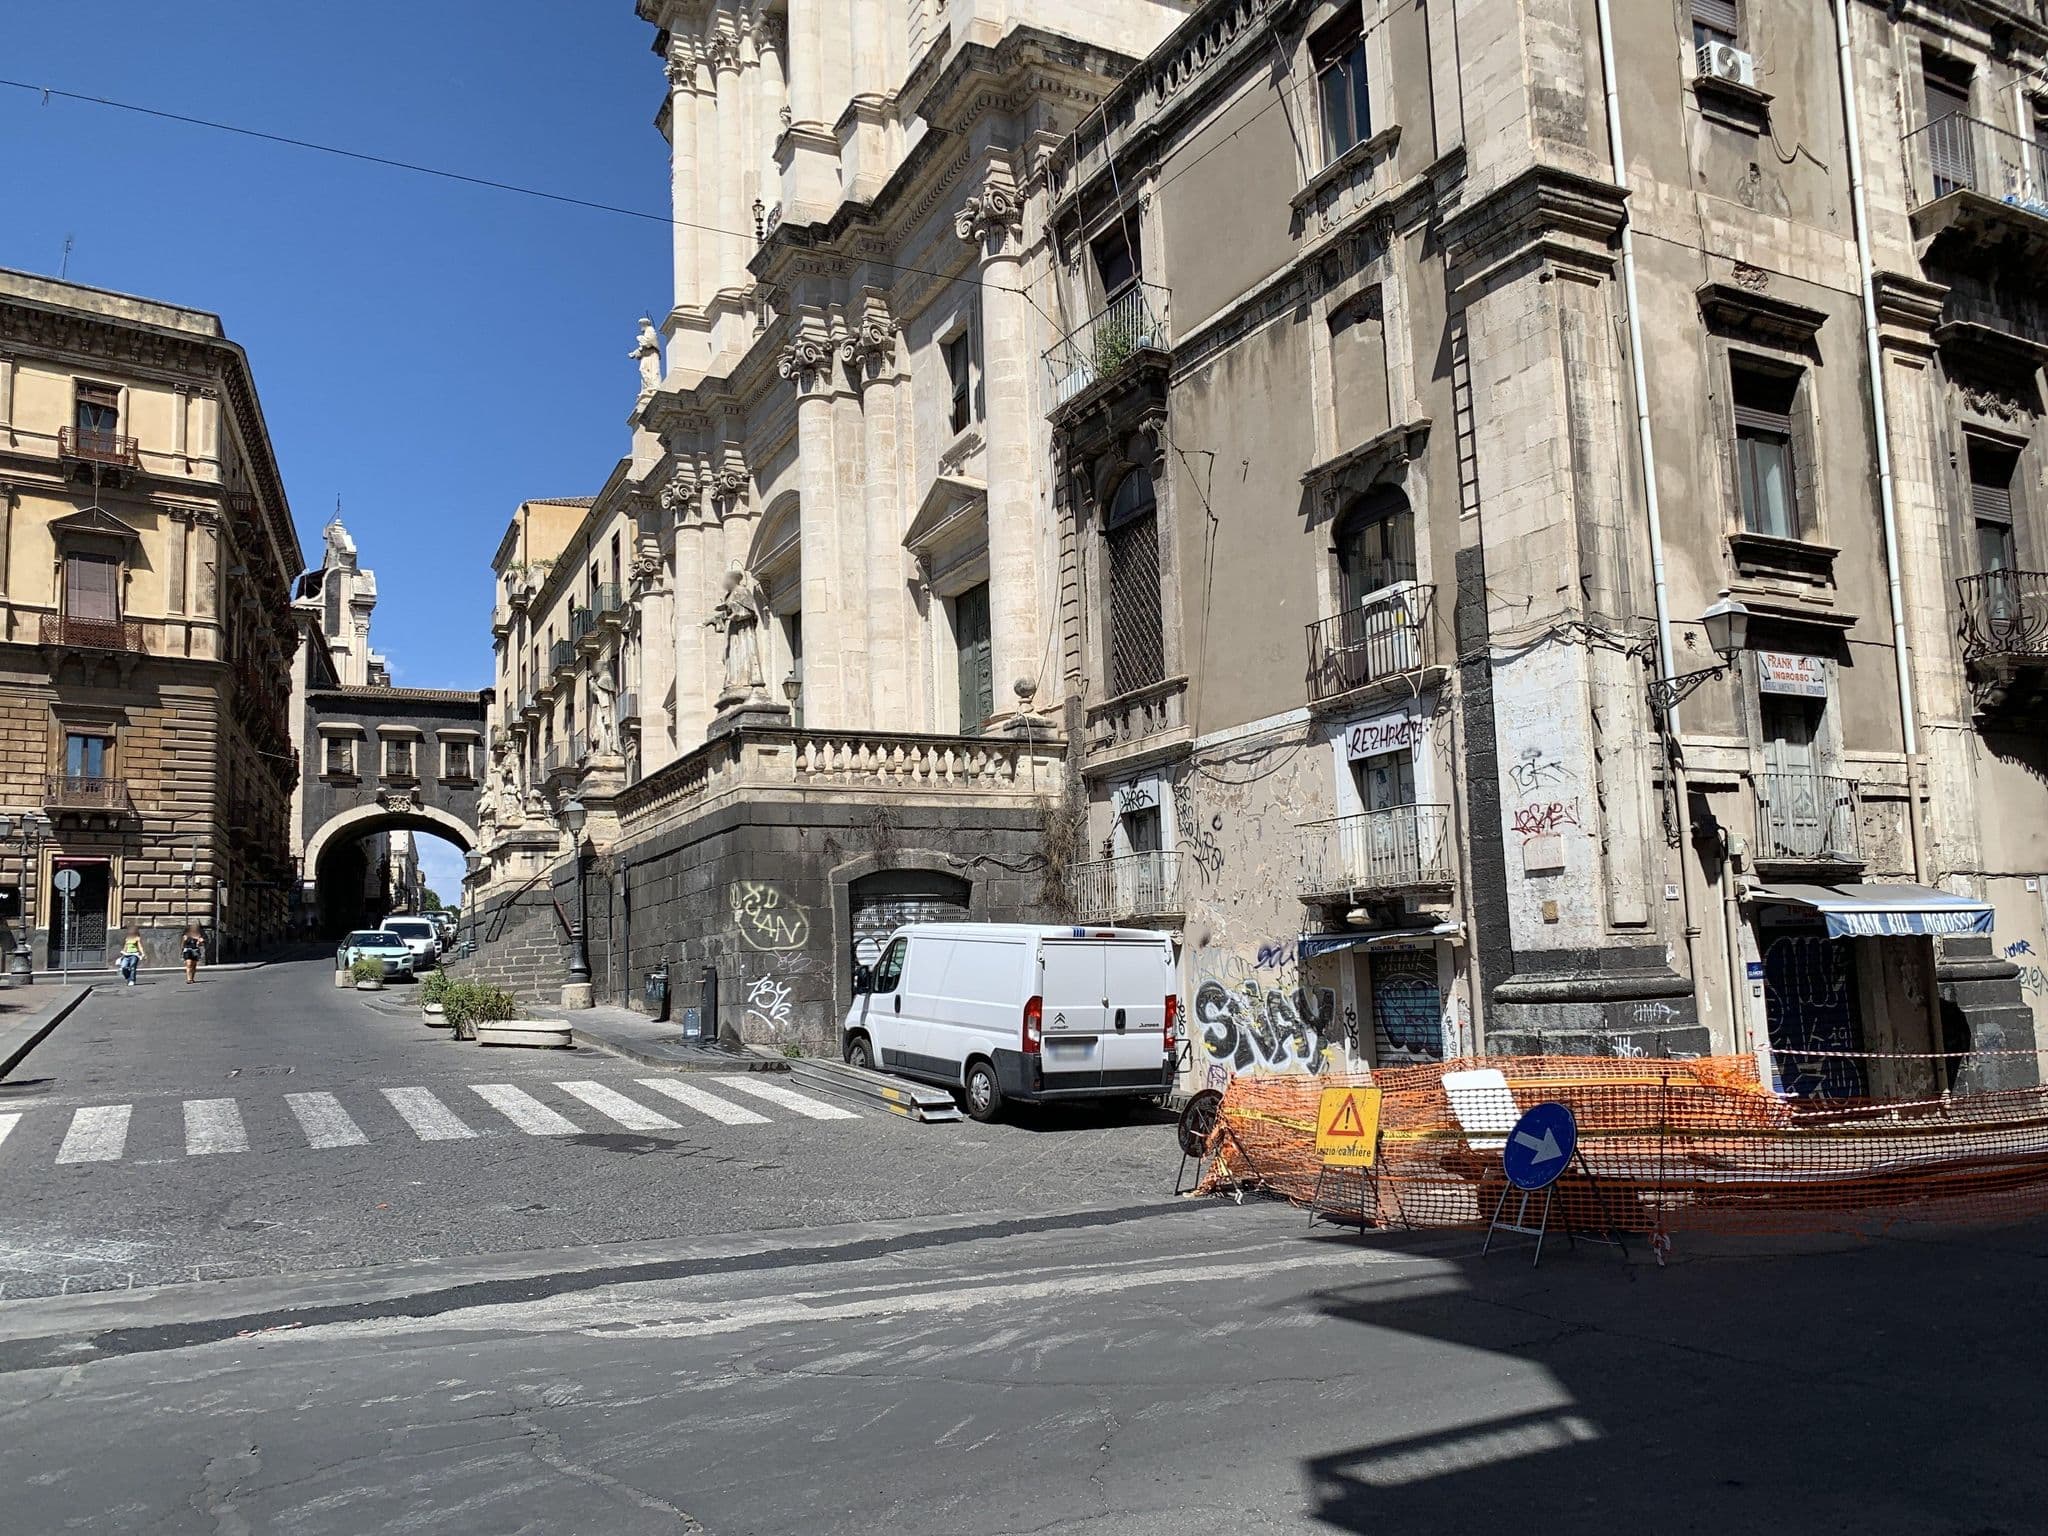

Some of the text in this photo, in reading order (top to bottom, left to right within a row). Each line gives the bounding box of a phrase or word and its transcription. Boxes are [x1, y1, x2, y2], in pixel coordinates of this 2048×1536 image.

[1767, 655, 1815, 671] FRANK BILL
[1773, 671, 1809, 682] INGROSSO
[1845, 911, 1975, 934] FRANK BILL INGROSSO
